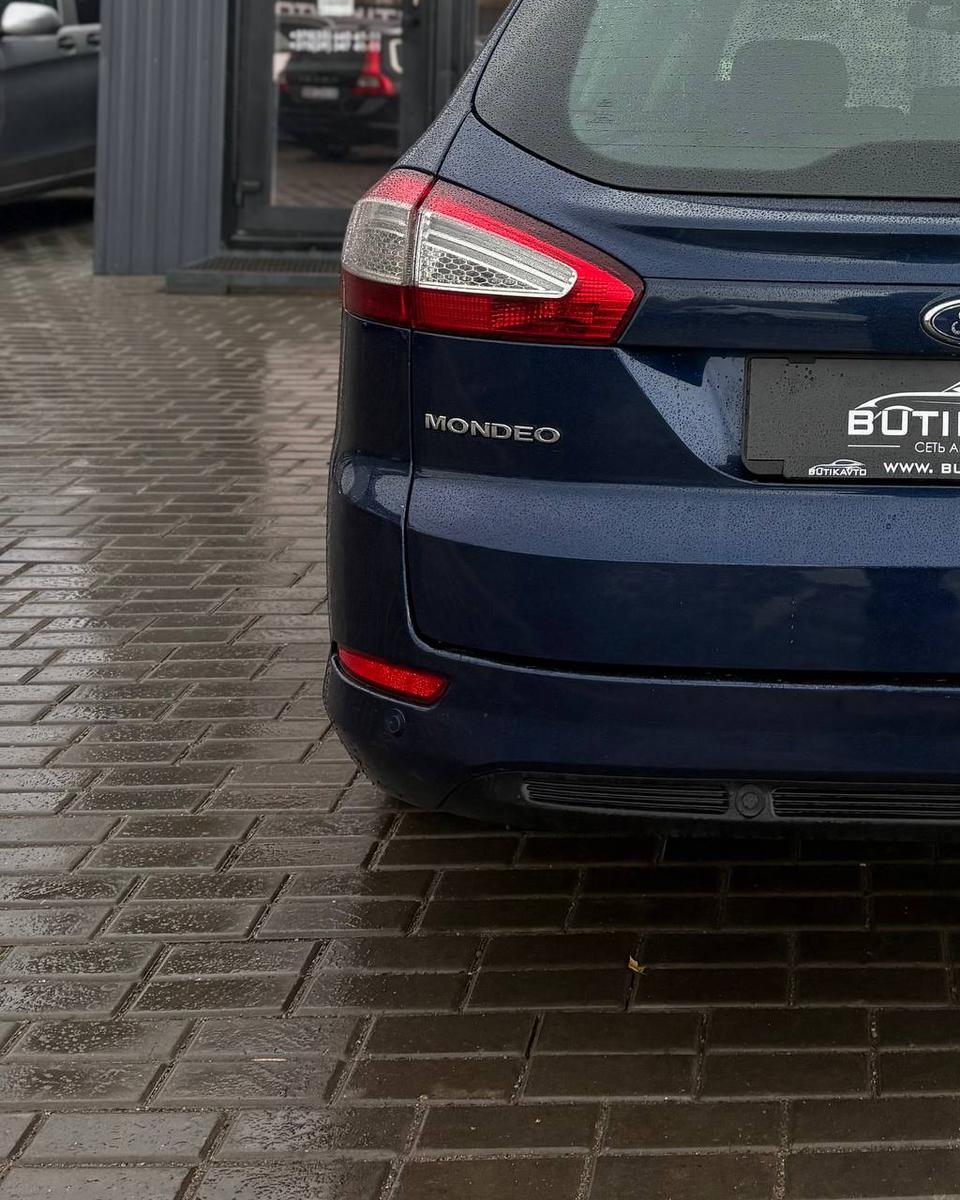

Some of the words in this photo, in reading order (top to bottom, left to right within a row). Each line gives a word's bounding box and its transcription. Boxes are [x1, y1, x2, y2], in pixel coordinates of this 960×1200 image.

[424, 413, 561, 444] MONDEO
[914, 441, 946, 454] СЕТЬ
[808, 467, 867, 476] BUTIKAVTO
[883, 462, 934, 474] WWW.
